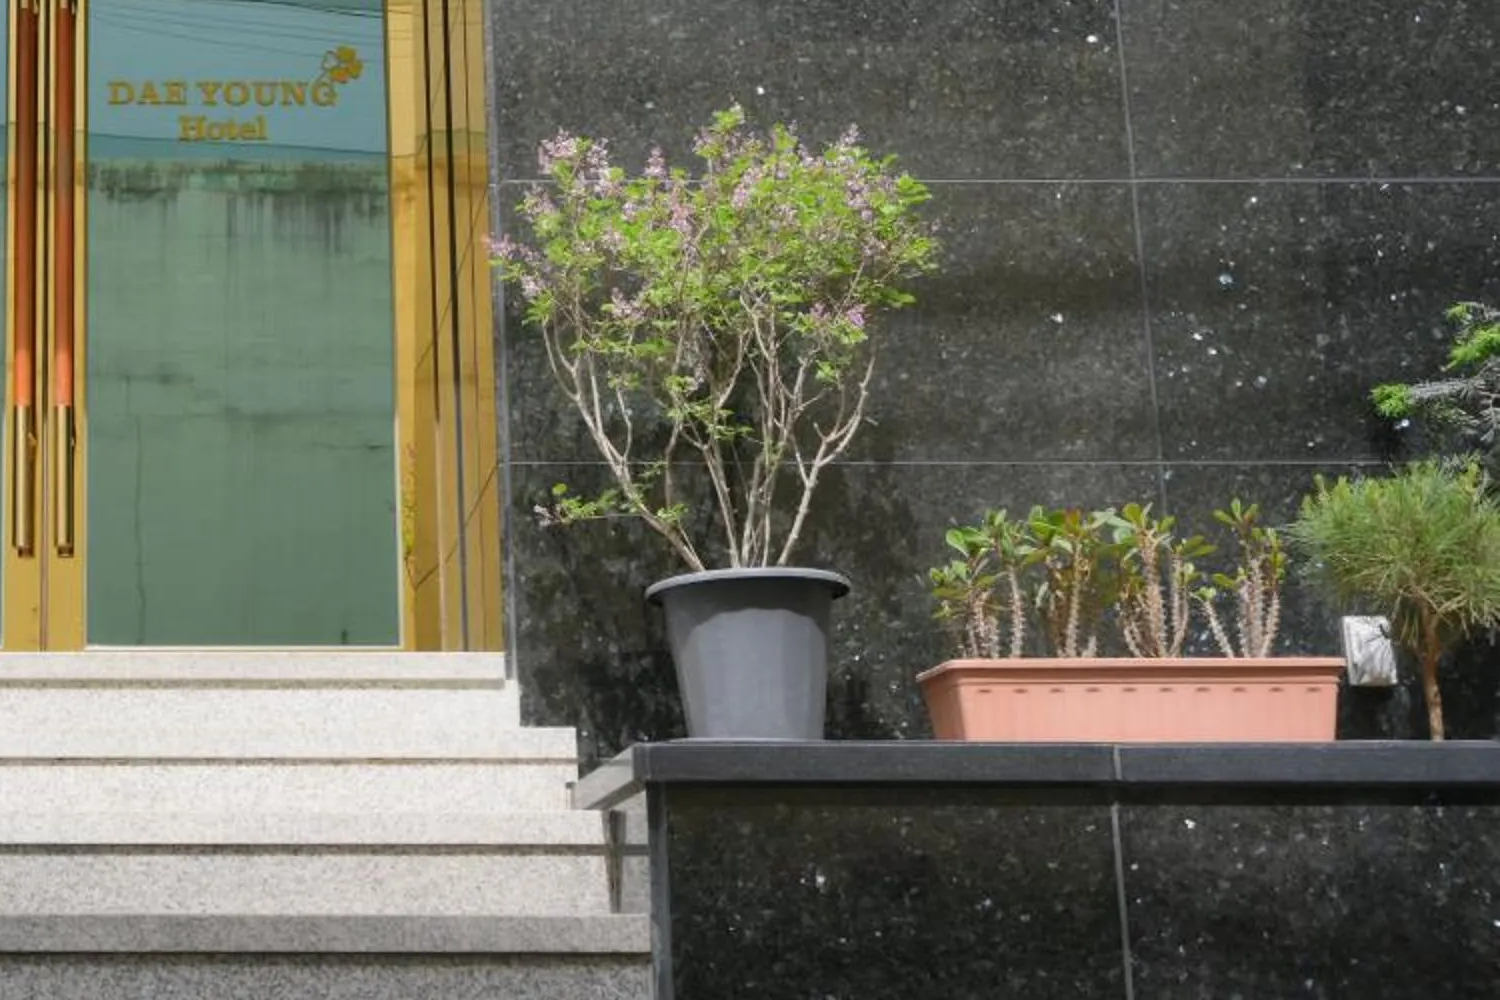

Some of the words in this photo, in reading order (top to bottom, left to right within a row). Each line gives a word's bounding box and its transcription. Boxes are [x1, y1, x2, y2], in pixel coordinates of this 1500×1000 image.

[107, 81, 187, 106] DAE
[196, 80, 337, 107] YOUNG
[179, 115, 268, 143] Hotel
